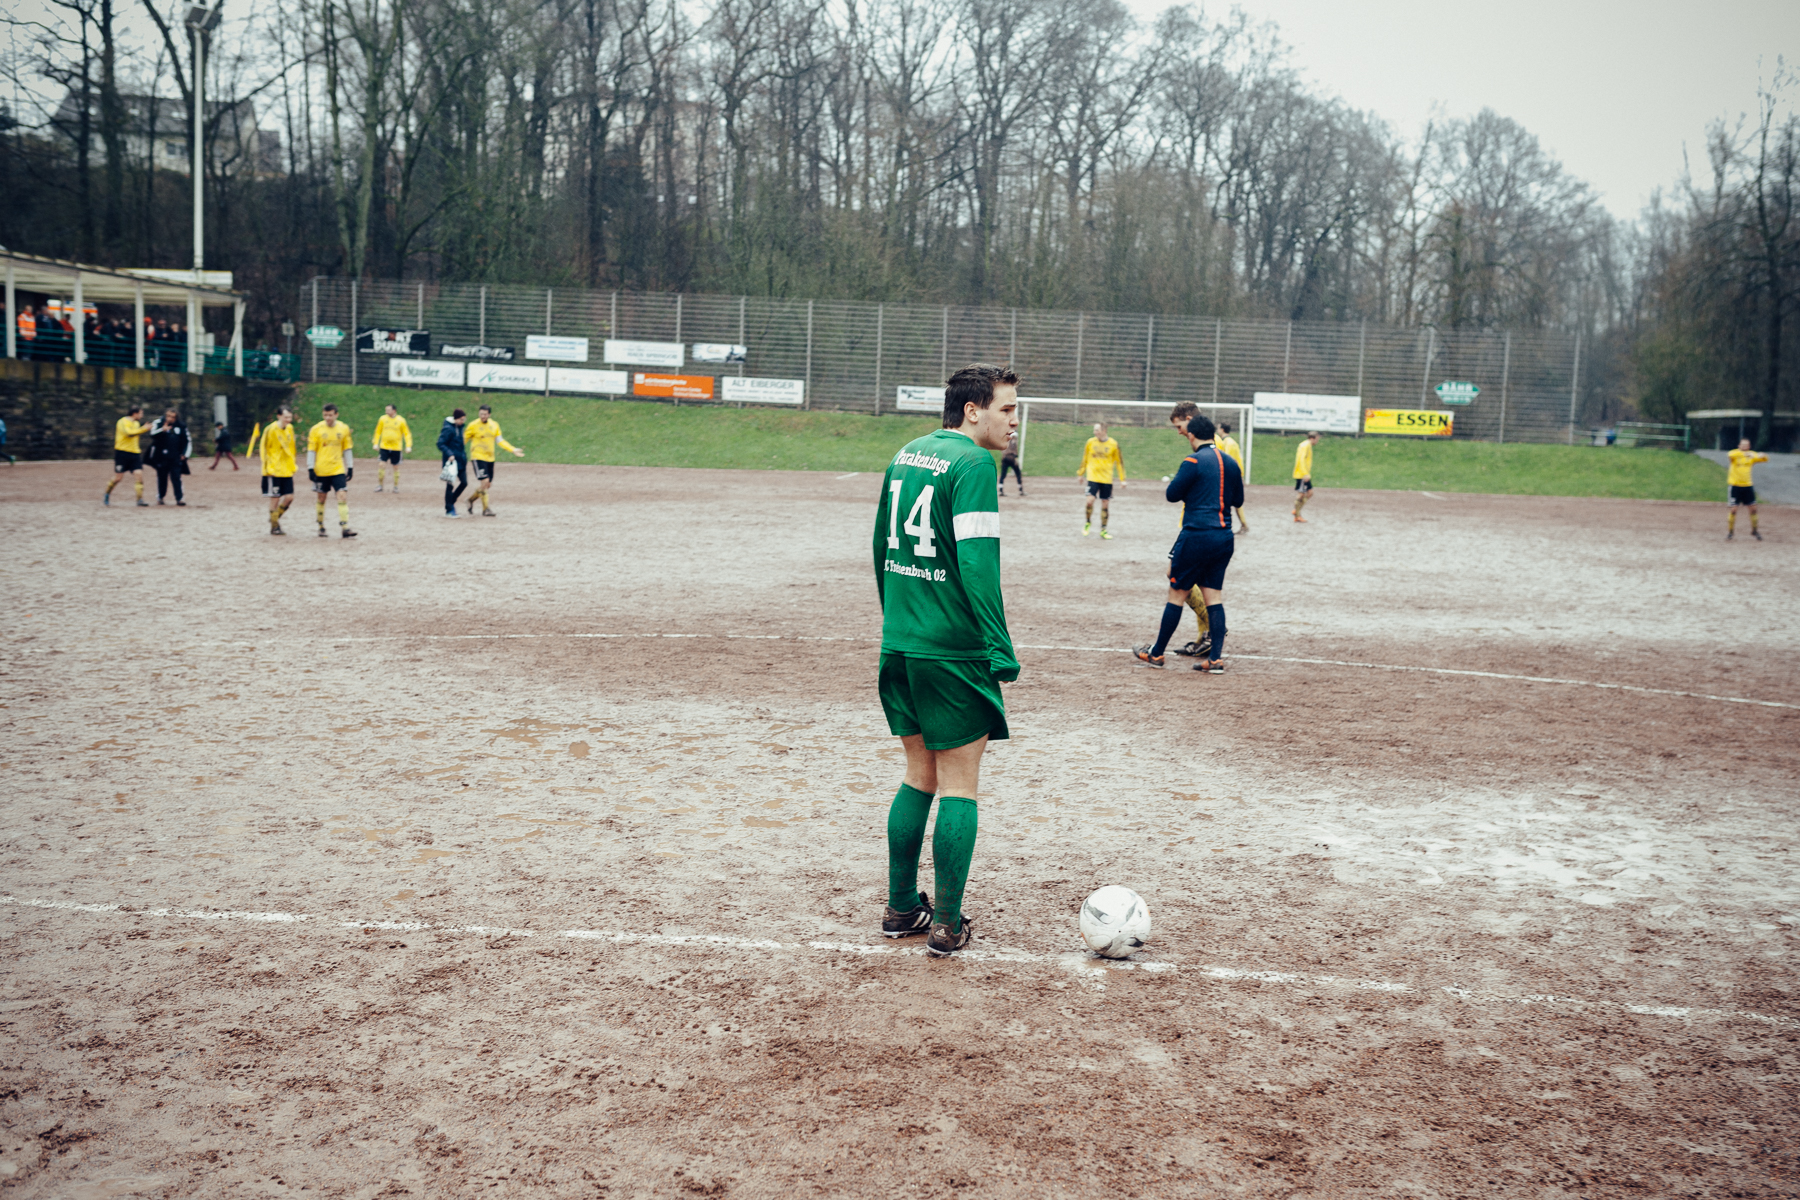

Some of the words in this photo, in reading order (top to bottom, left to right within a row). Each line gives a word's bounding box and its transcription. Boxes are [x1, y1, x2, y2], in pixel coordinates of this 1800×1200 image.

[406, 363, 440, 377] Stauder
[732, 379, 747, 387] ALT
[750, 380, 795, 389] EIBERGER
[1396, 413, 1450, 427] ESSEN
[887, 479, 937, 558] 14
[933, 568, 946, 582] 02
